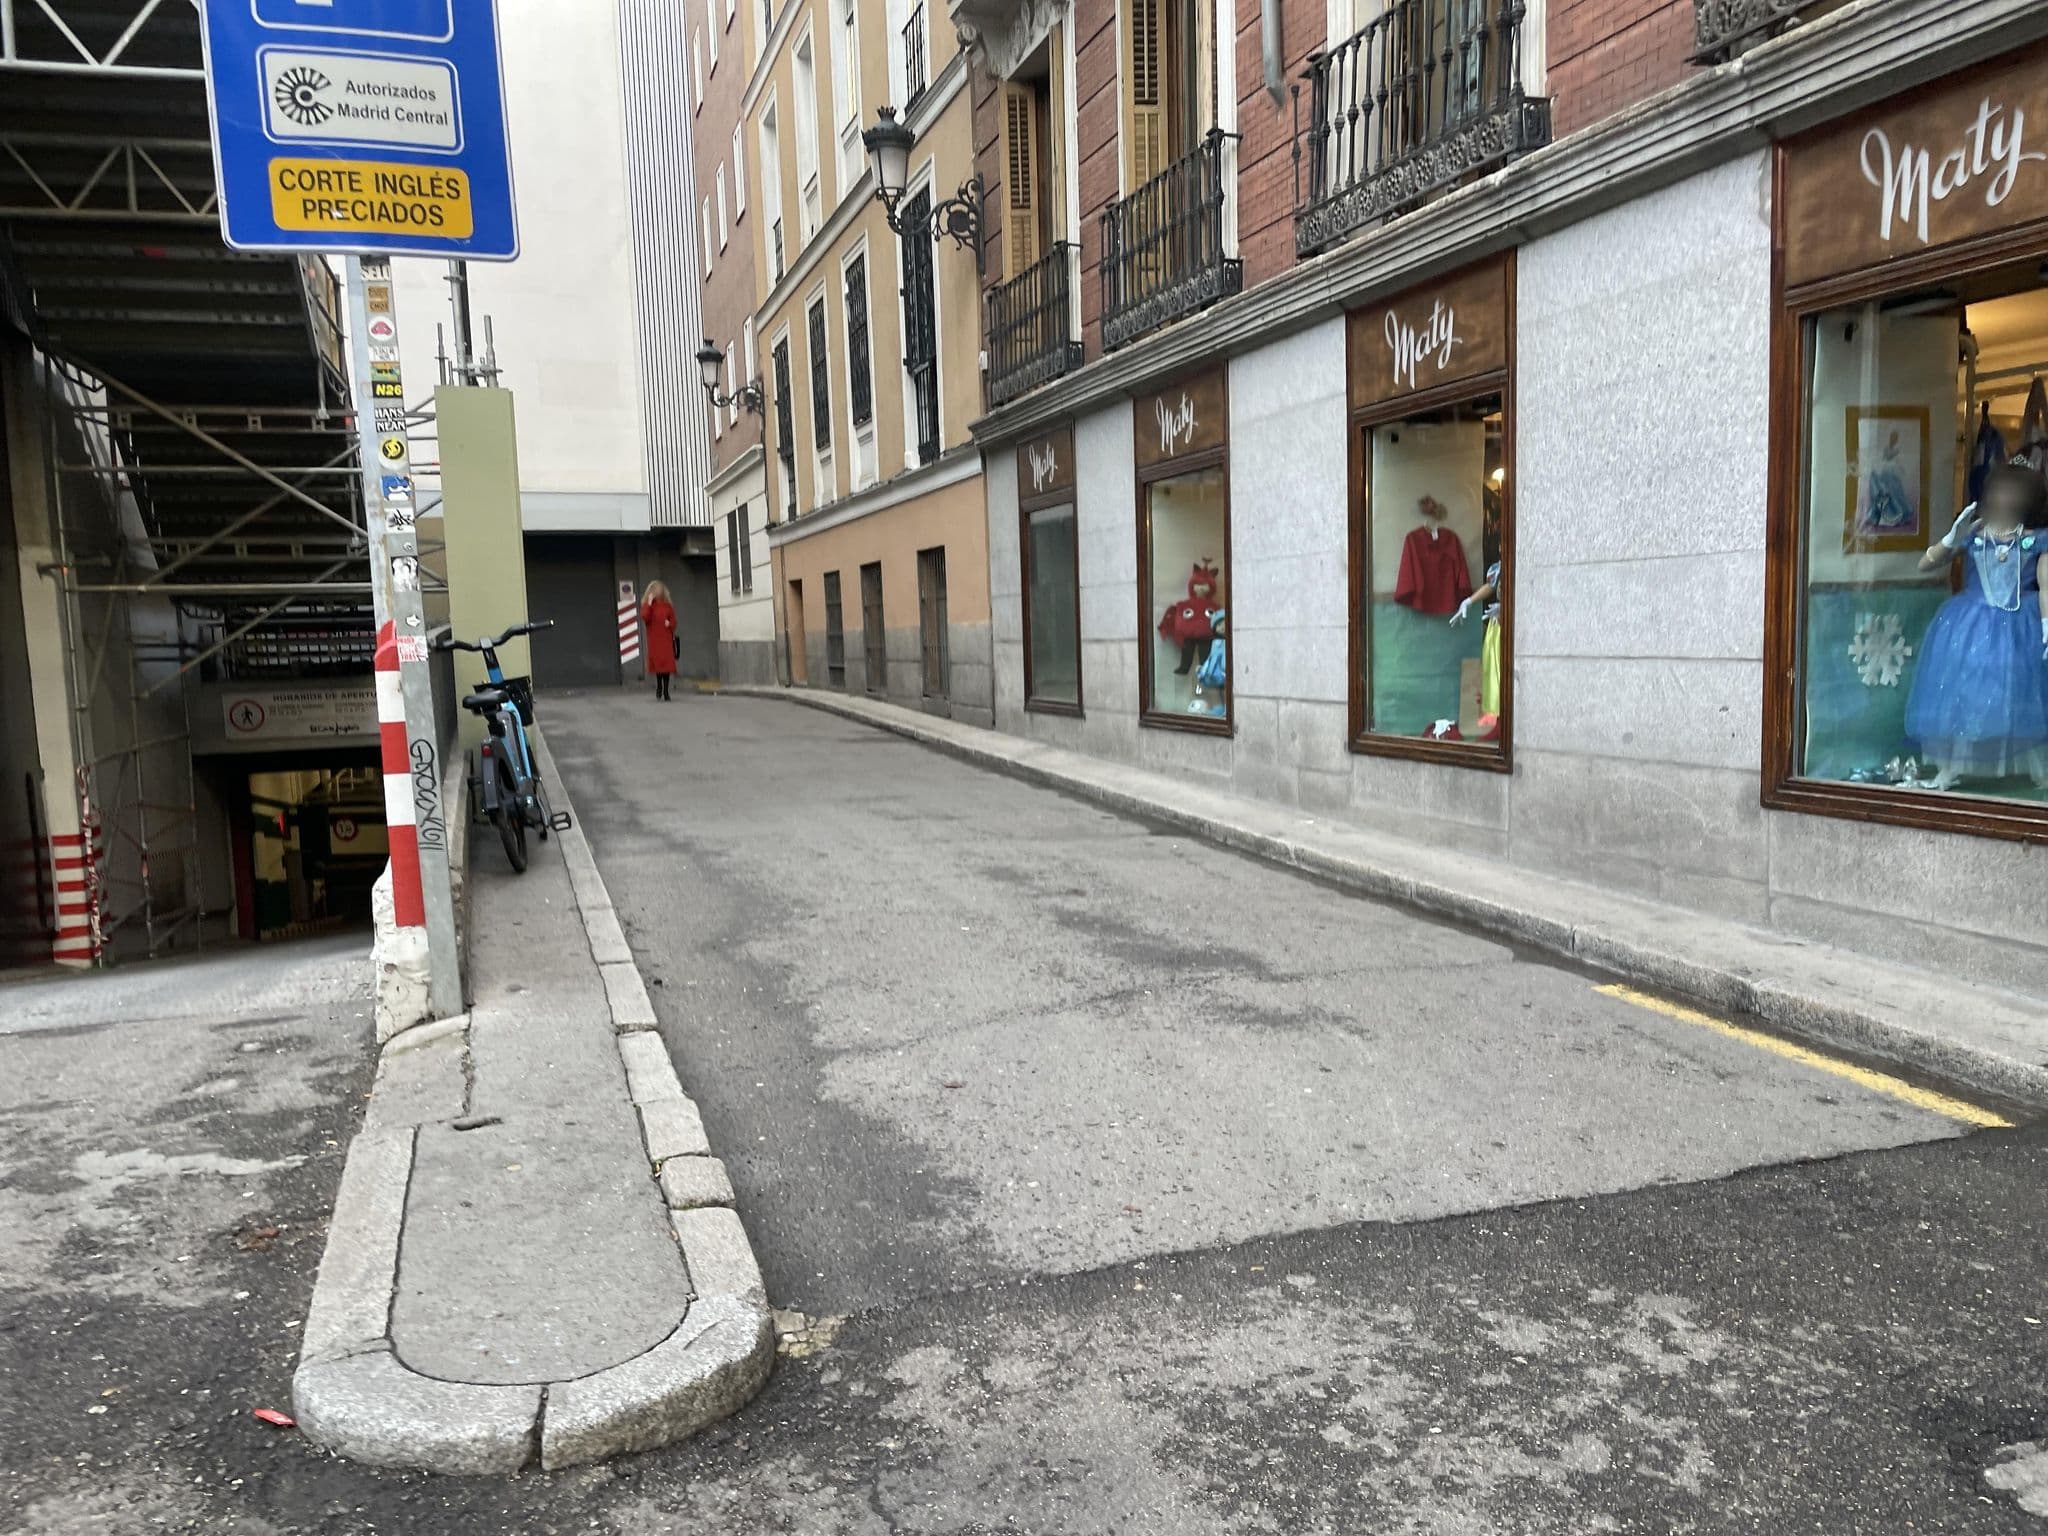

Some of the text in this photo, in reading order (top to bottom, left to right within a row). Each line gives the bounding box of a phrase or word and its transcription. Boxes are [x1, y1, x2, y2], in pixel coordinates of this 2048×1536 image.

[344, 79, 437, 102] Autorizados
[336, 103, 449, 126] Madrid Central
[278, 168, 462, 201] CORTE INGLÉS
[1860, 95, 2047, 245] Maty
[302, 198, 445, 227] PRECIADOS
[1384, 297, 1464, 390] Maty
[376, 383, 402, 396] N26
[1156, 391, 1199, 456] Maty
[1028, 442, 1058, 493] Maty
